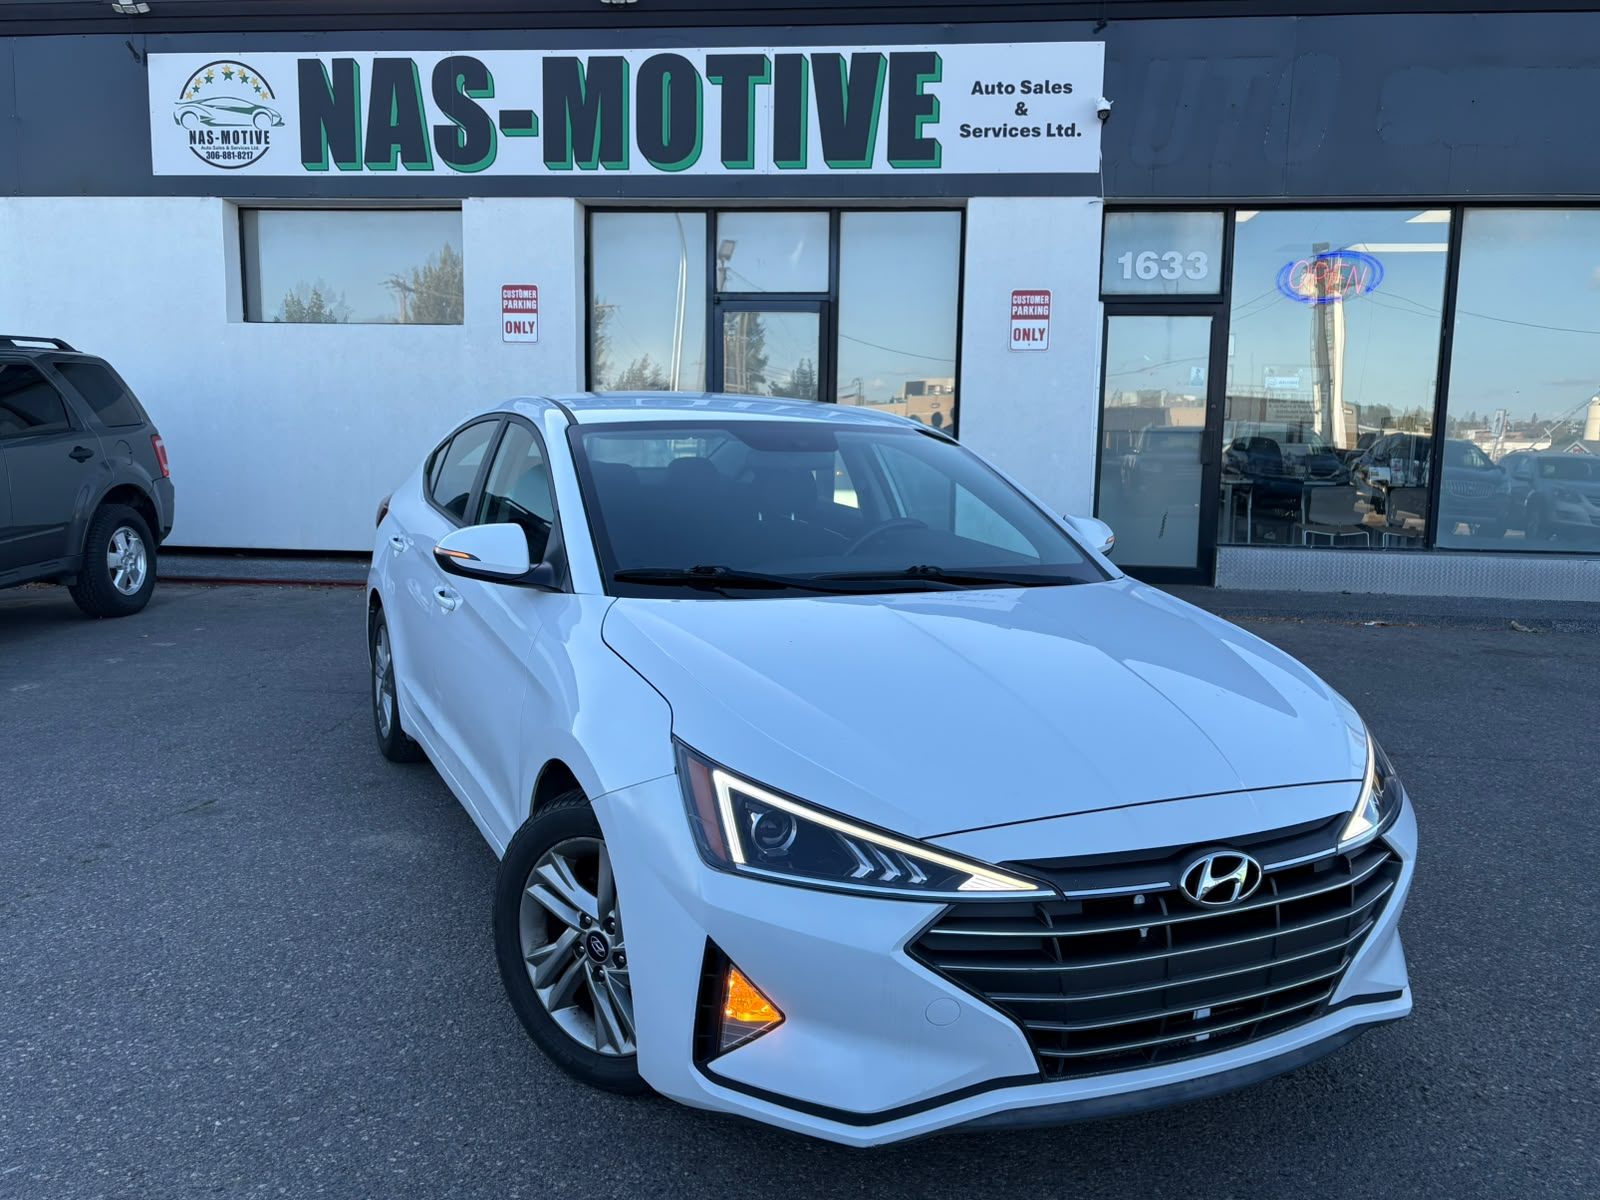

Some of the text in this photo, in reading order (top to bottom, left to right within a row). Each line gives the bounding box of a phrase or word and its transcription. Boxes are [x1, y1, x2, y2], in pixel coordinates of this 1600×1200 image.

[971, 79, 1073, 95] Auto Sales
[297, 51, 943, 173] NAS-MOTIVE
[1014, 101, 1028, 116] &
[188, 130, 270, 145] NAS-MOTIVE
[959, 122, 1082, 138] Services Ltd.
[206, 151, 253, 160] 306-881-8217
[1117, 251, 1209, 281] 1633
[1288, 258, 1367, 294] OPEN
[503, 289, 537, 299] CUSTOMER
[1012, 295, 1049, 304] CUSTOMER
[503, 299, 537, 309] PARKING
[1012, 305, 1049, 316] PARKING
[505, 320, 535, 335] ONLY
[1013, 327, 1046, 342] ONLY
